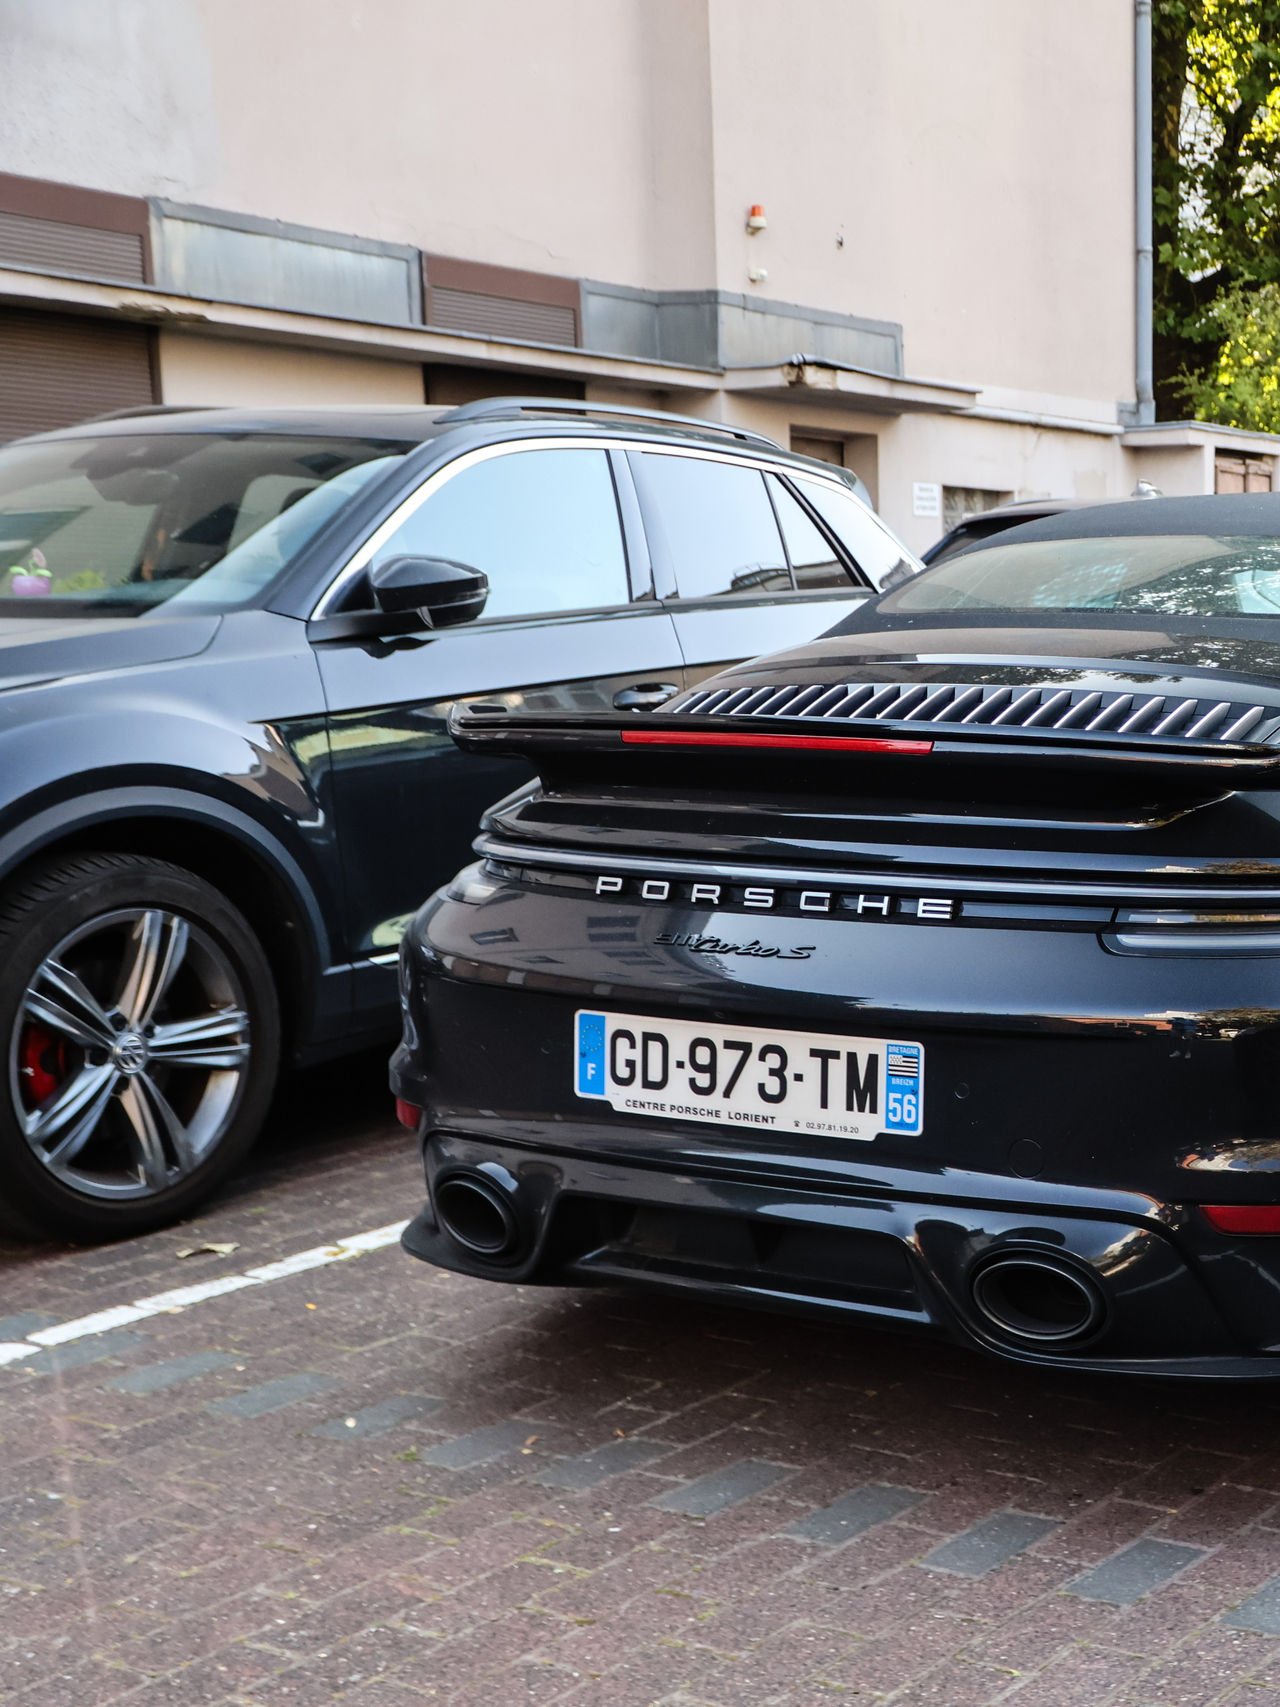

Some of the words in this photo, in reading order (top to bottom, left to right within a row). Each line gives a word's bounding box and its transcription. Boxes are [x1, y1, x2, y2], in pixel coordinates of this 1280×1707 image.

[595, 876, 954, 920] PORSCHE
[689, 936, 780, 957] Turbo
[777, 945, 816, 959] S
[888, 1045, 918, 1055] BRETAGNE
[587, 1062, 597, 1080] F
[610, 1028, 879, 1114] GD-973-TM
[891, 1077, 914, 1086] BREIZH
[625, 1099, 666, 1112] CENTRE
[669, 1104, 721, 1118] PORSCHE
[728, 1111, 776, 1124] LORIENT
[805, 1121, 859, 1134] 02.97.81.19.20
[888, 1092, 917, 1124] 56
